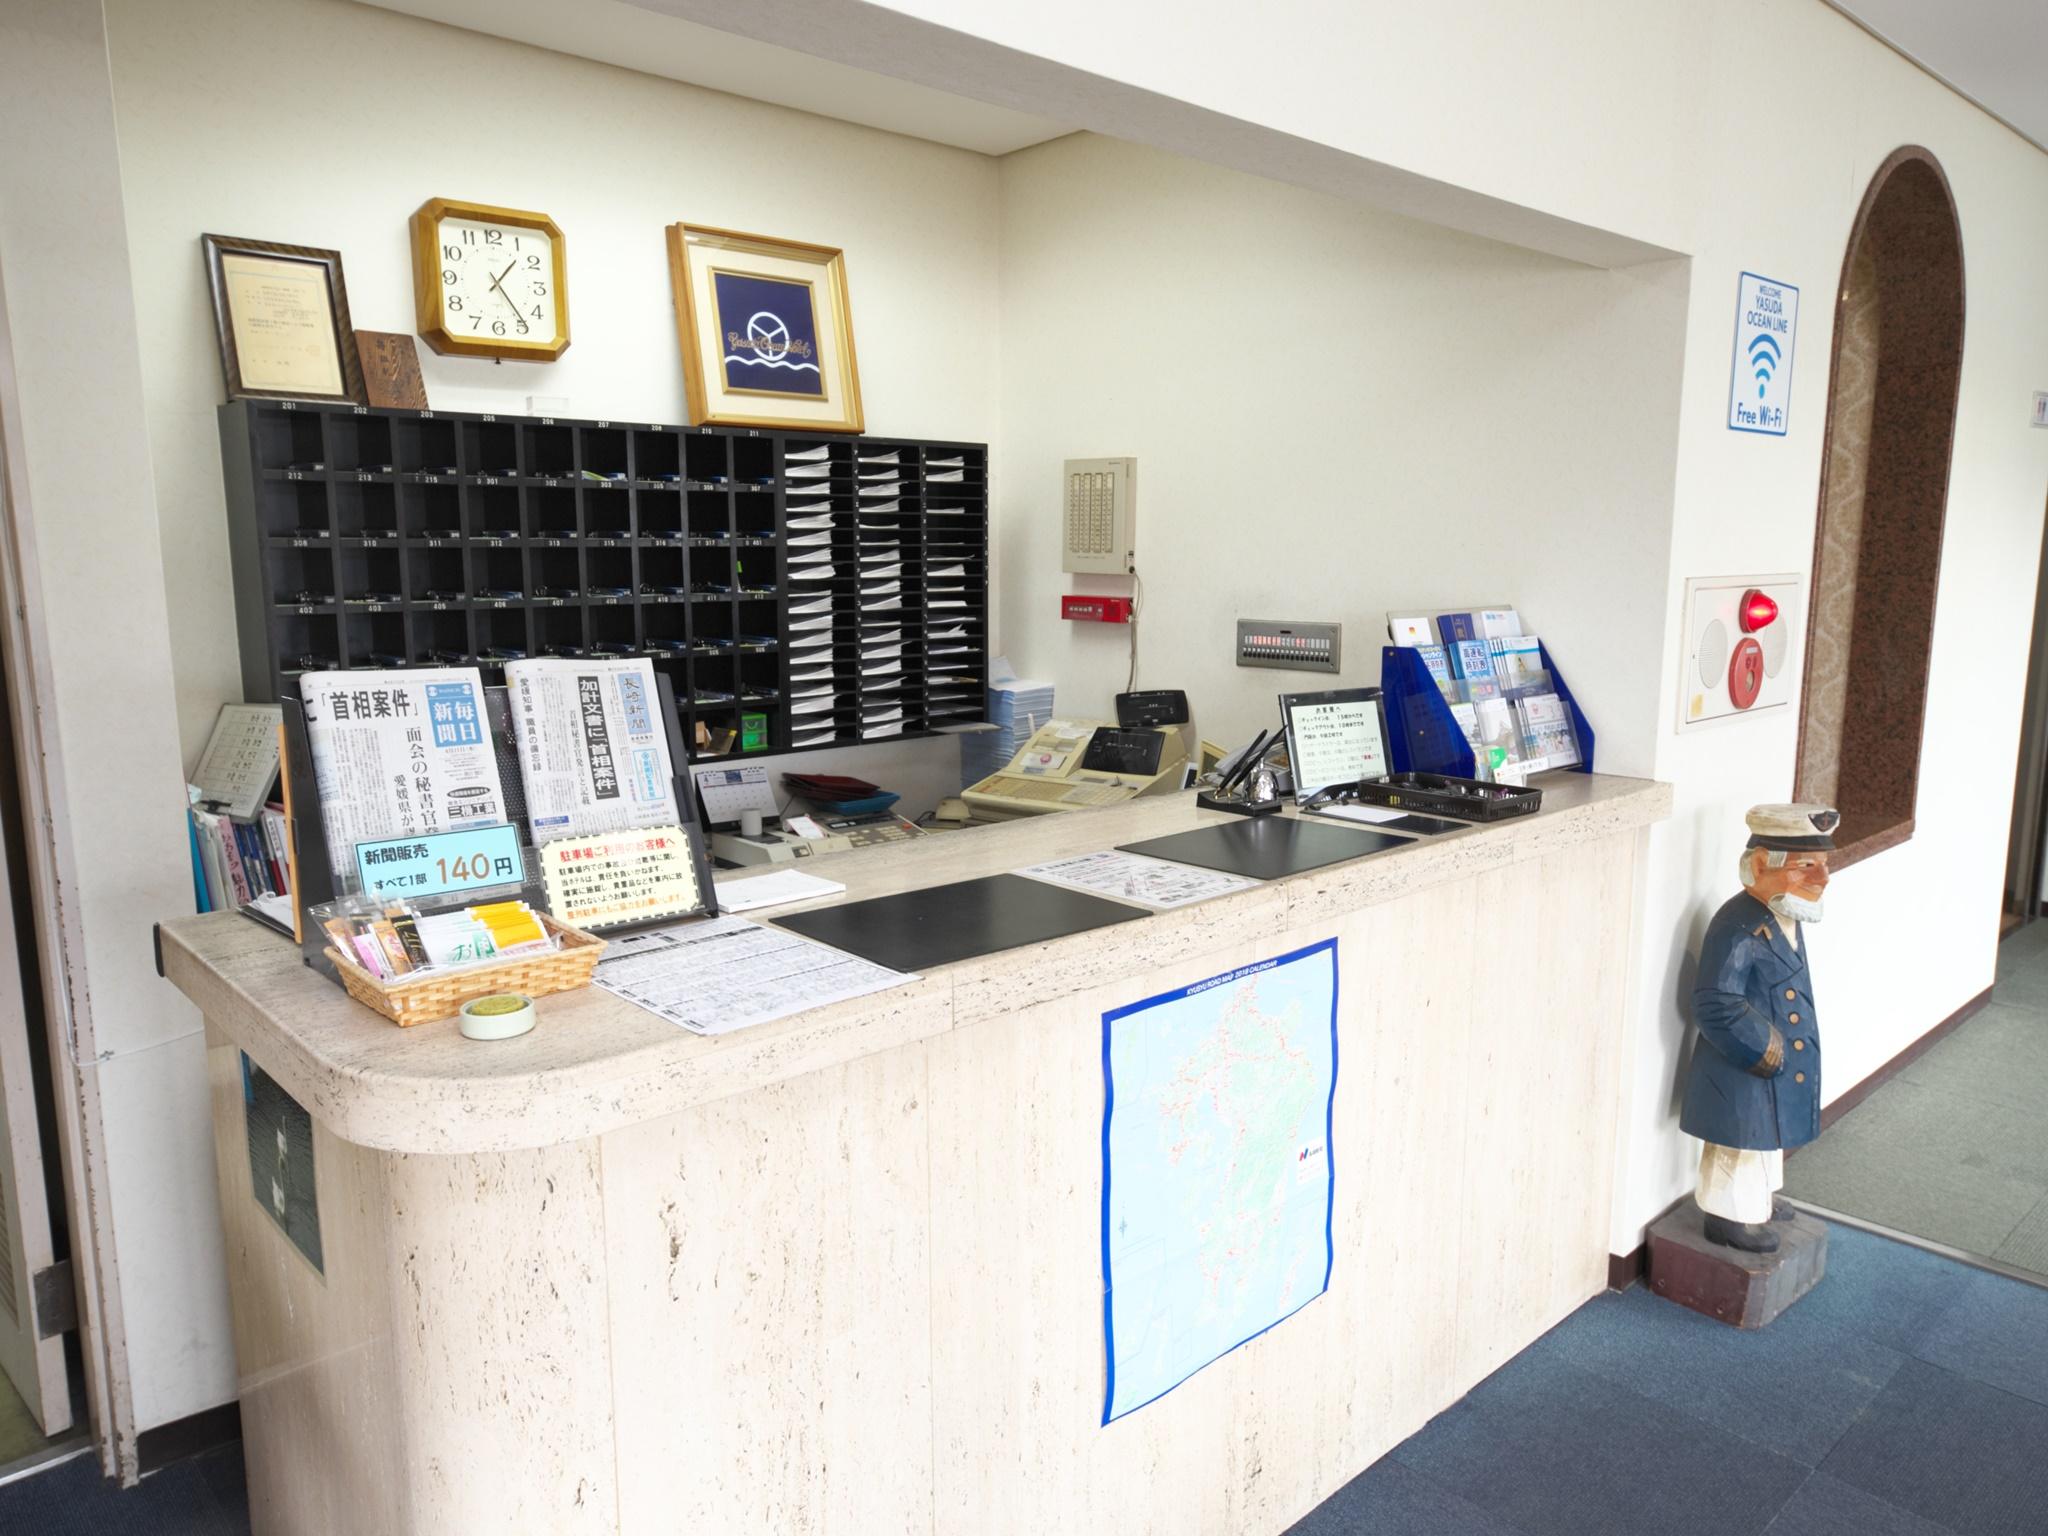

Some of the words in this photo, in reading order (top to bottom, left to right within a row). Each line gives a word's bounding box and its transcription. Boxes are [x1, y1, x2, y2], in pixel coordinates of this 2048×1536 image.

[463, 230, 475, 245] 11
[484, 229, 502, 246] 12
[515, 237, 520, 252] 1
[444, 245, 462, 261] 10
[526, 255, 541, 271] 2
[442, 270, 457, 285] 9
[533, 281, 546, 296] 3
[1759, 285, 1782, 299] WELCOME
[448, 295, 463, 311] 8
[1756, 295, 1783, 315] YASUDA
[530, 304, 544, 320] 4
[468, 315, 482, 330] 7
[491, 320, 506, 336] 6
[516, 319, 529, 335] 5
[1747, 311, 1772, 330] OCEAN
[1773, 318, 1788, 333] LINE
[282, 402, 296, 410] 201
[353, 406, 368, 415] 202
[1737, 402, 1757, 425] Free
[1760, 405, 1783, 428] Wi-Fi
[288, 472, 303, 480] 212
[299, 606, 313, 614] 402
[365, 843, 429, 865] 新聞販売
